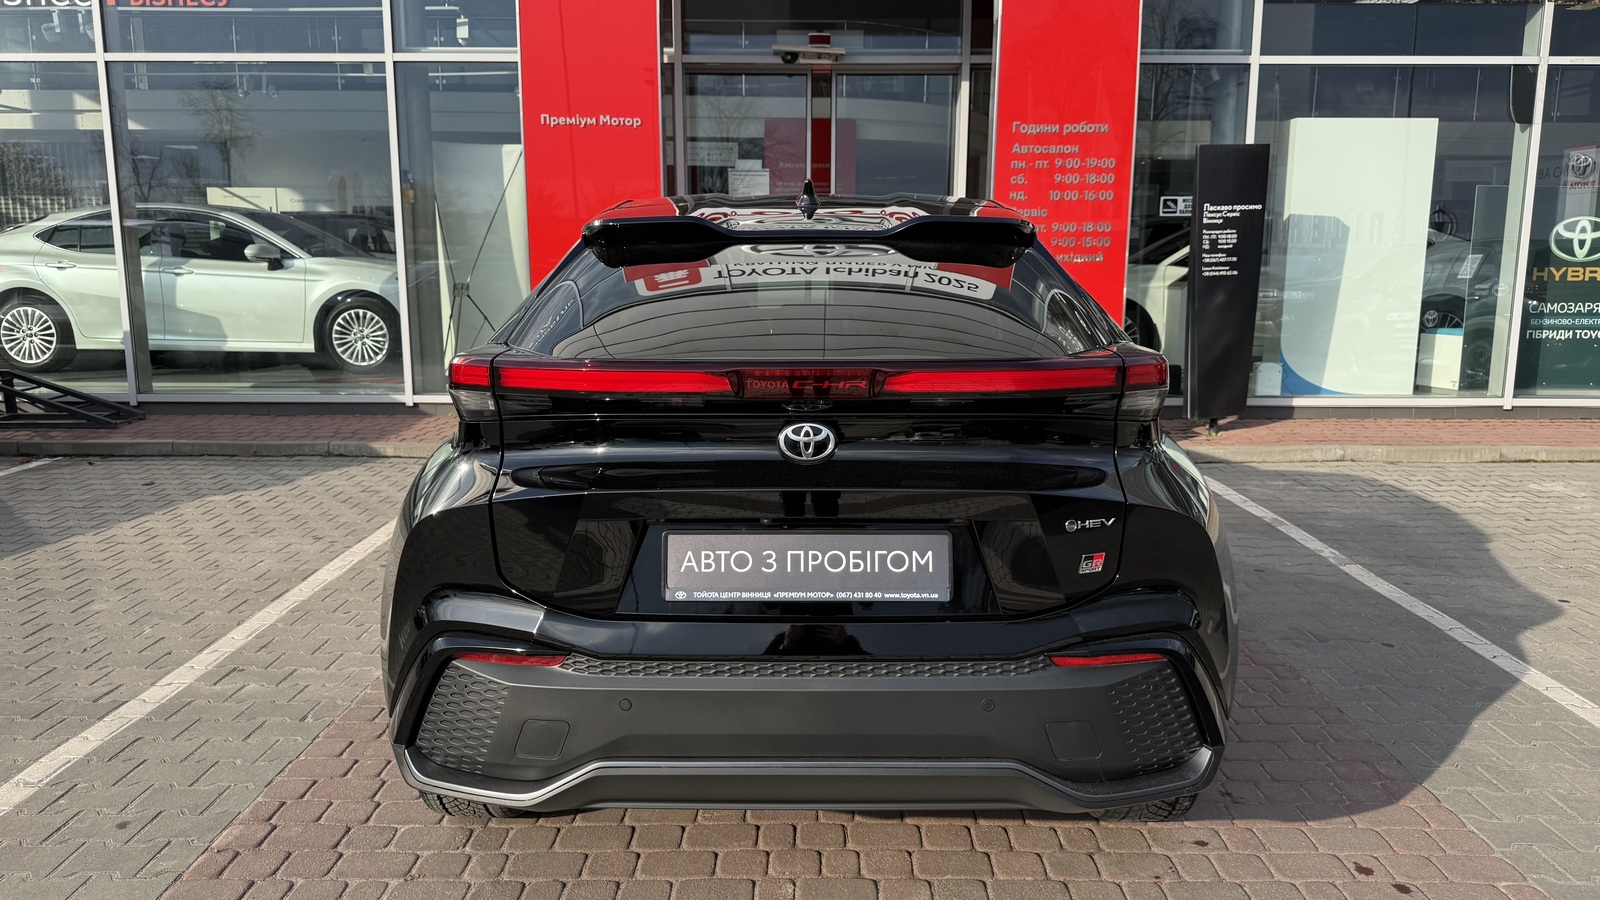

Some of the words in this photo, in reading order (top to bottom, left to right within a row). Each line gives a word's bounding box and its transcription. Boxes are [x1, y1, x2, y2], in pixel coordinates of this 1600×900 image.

[540, 114, 596, 127] Преміум
[600, 114, 642, 128] Мотор
[1012, 122, 1060, 135] Години
[1063, 121, 1109, 136] роботи
[1012, 143, 1079, 154] Автосалон
[1054, 158, 1116, 169] 9:00-19:00
[1010, 174, 1028, 185] сб.
[1054, 173, 1115, 184] 9:00-18:00
[1009, 190, 1028, 201] нд.
[1049, 190, 1114, 201] 10:00-16:00
[1203, 203, 1232, 211] Ласкаво
[1051, 222, 1112, 232] 9:00-18:00
[1051, 237, 1112, 248] 9:00-15:00
[1056, 252, 1104, 263] ихідний
[1529, 302, 1600, 314] САМОЗАРЯ
[1526, 330, 1573, 340] ГІБРИДИ
[746, 380, 789, 389] TOYOTA
[792, 380, 867, 389] C-HR
[1078, 518, 1116, 529] HEV
[680, 550, 753, 573] АВТО
[761, 550, 777, 573] З
[787, 550, 934, 573] ПРОБІГОМ
[1082, 560, 1103, 568] GR
